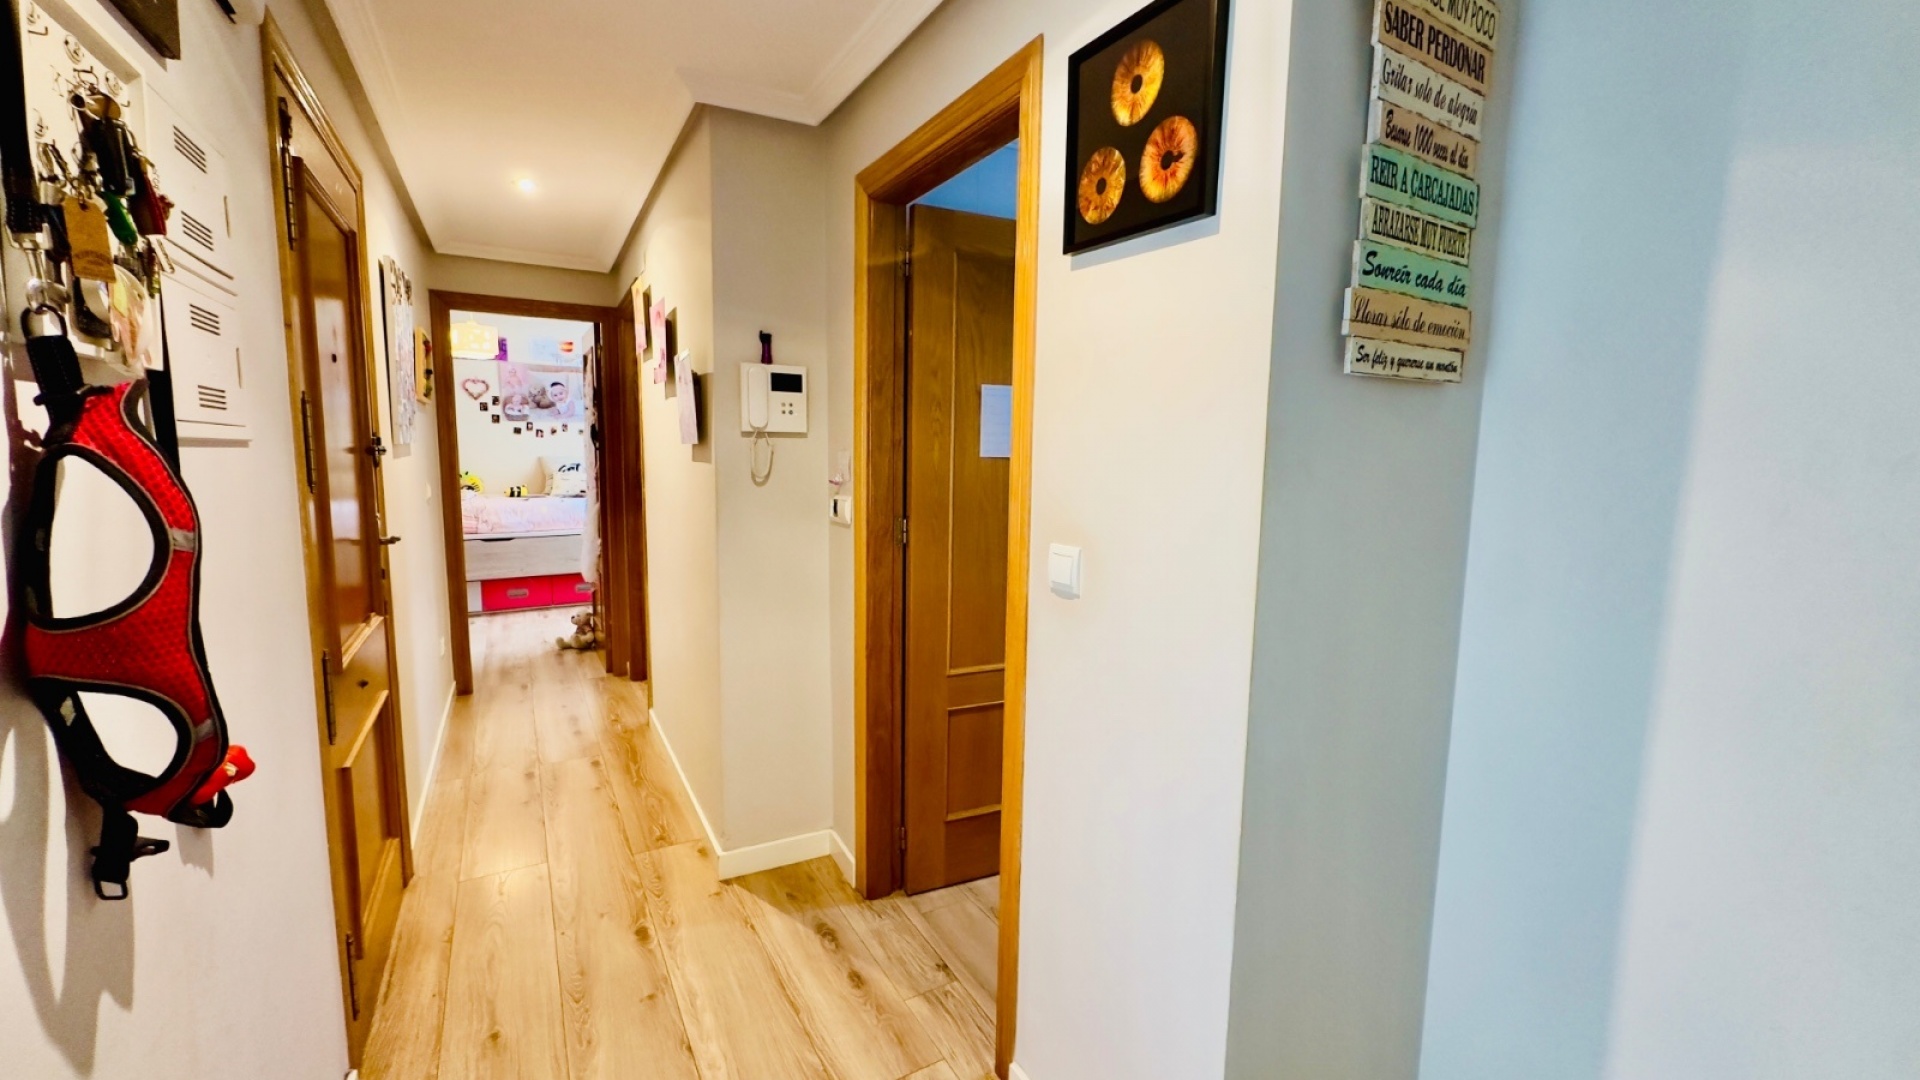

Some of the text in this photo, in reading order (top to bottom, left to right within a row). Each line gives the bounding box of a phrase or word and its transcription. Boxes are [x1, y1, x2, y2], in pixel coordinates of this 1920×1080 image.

[1384, 1, 1485, 84] SABER PERDONAR
[1470, 1, 1496, 40] POCO
[1434, 84, 1447, 110] de
[1413, 123, 1434, 155] 1000
[1449, 141, 1459, 165] al
[1400, 166, 1408, 194] A
[1409, 169, 1475, 216] CARCAJADAS
[1371, 204, 1467, 259] ABRAZARSE MUY FUERTE
[1362, 250, 1467, 298] Sonreír cada día
[1354, 294, 1466, 340] Llorar sólo de emoción
[1355, 344, 1370, 364] Ser
[1371, 348, 1388, 371] feliz
[1389, 356, 1395, 371] y
